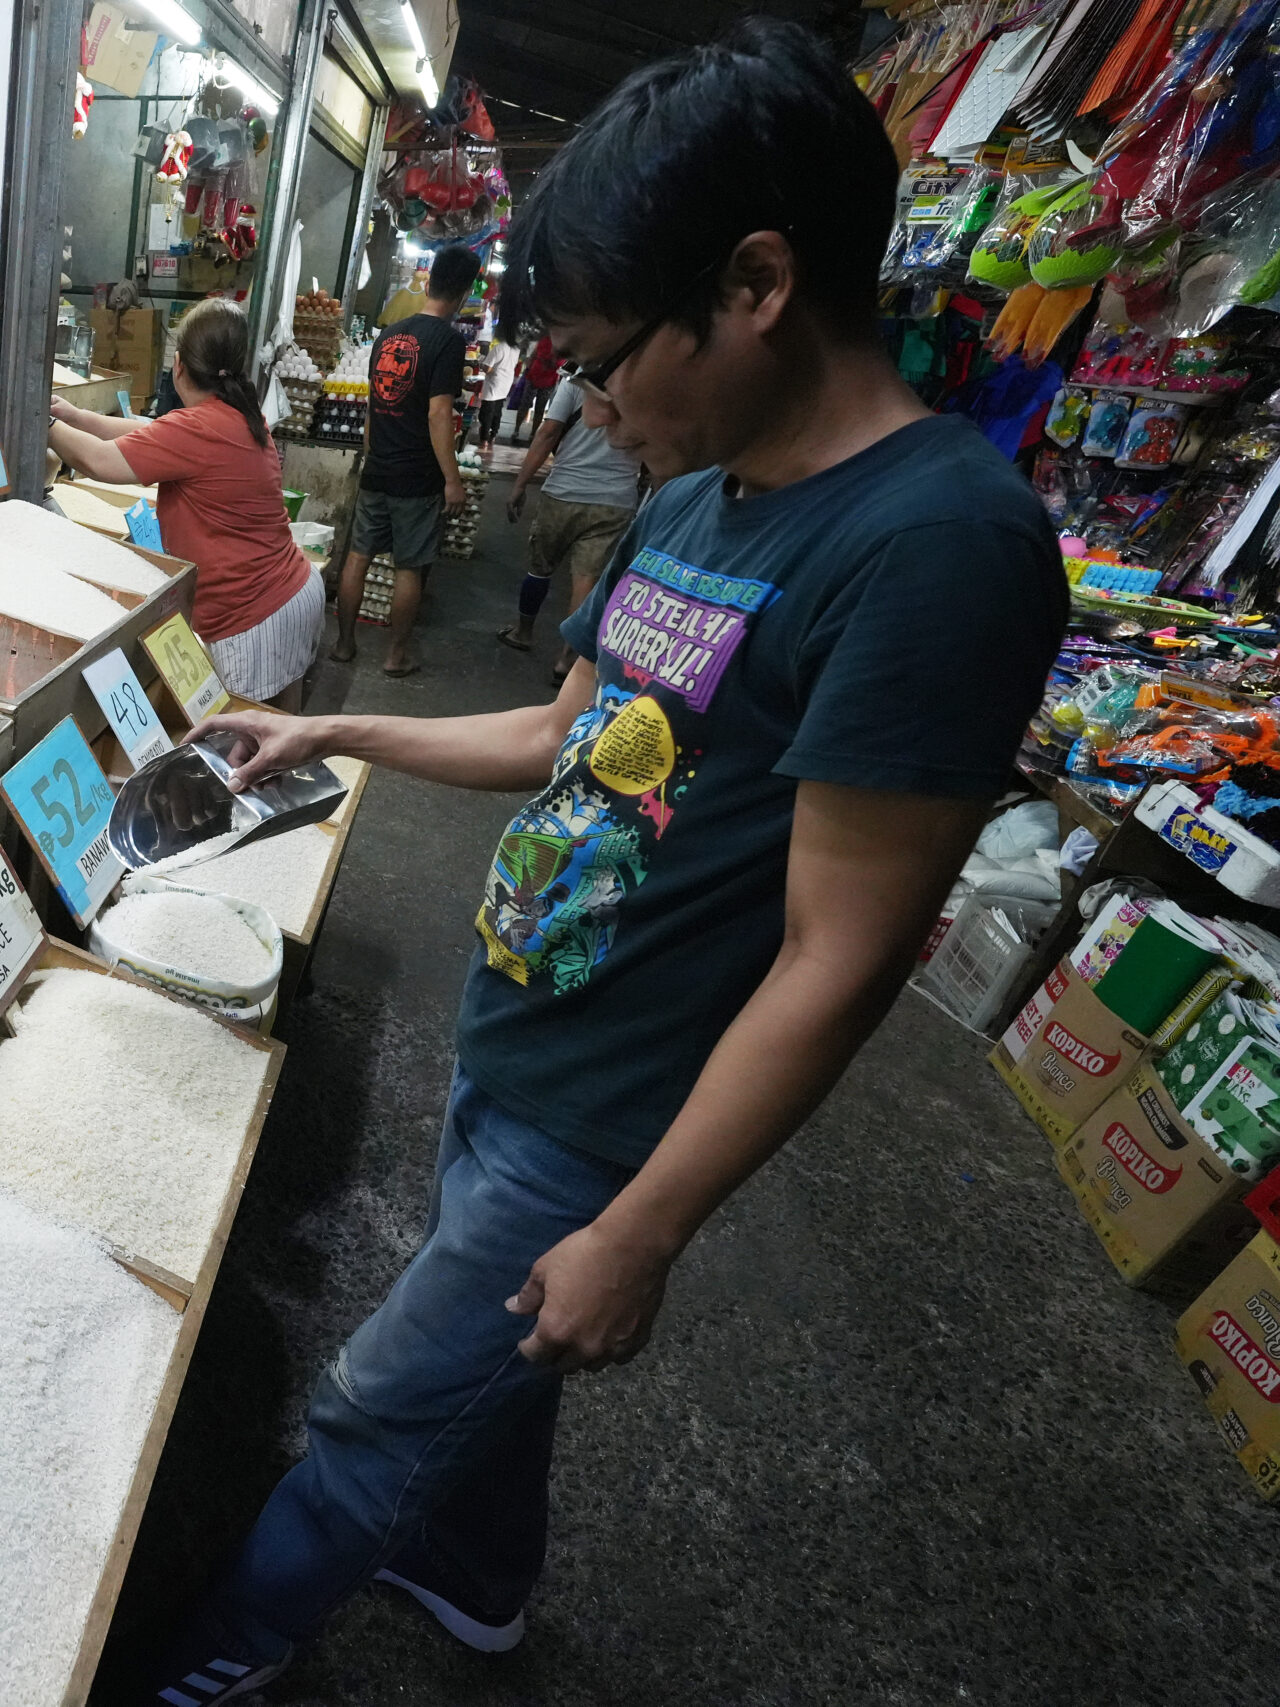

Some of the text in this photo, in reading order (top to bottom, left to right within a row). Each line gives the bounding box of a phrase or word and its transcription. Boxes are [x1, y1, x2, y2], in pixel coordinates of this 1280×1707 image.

[622, 581, 651, 612] TO
[110, 682, 148, 736] 48
[1041, 1051, 1075, 1092] Blanca
[1047, 1023, 1105, 1074] KOPIKO
[1096, 1156, 1132, 1210] Blanca
[1107, 1126, 1165, 1190] KOPIKO
[1211, 1315, 1280, 1397] KOPIKO
